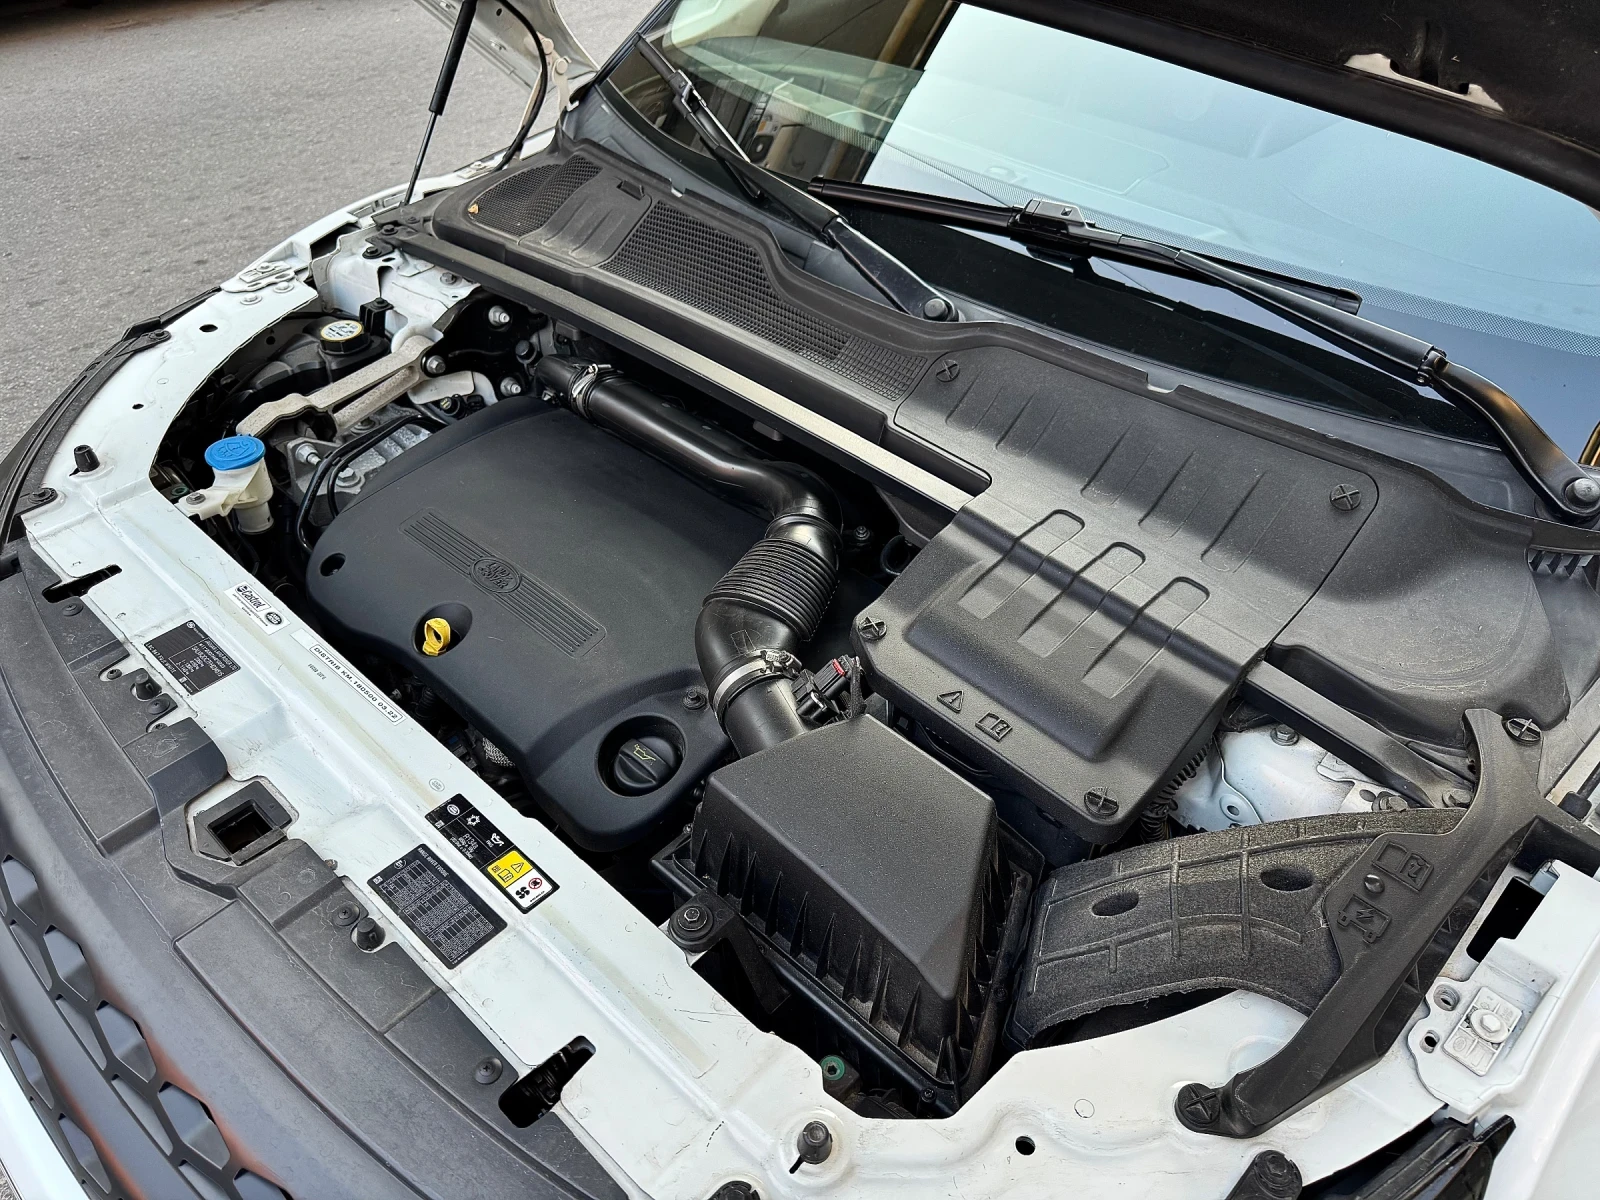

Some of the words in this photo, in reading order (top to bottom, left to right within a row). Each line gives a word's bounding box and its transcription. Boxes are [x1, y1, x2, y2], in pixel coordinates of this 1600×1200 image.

[241, 589, 266, 609] Castrol
[314, 648, 341, 671] DISTRIB
[378, 702, 398, 719] 03.22
